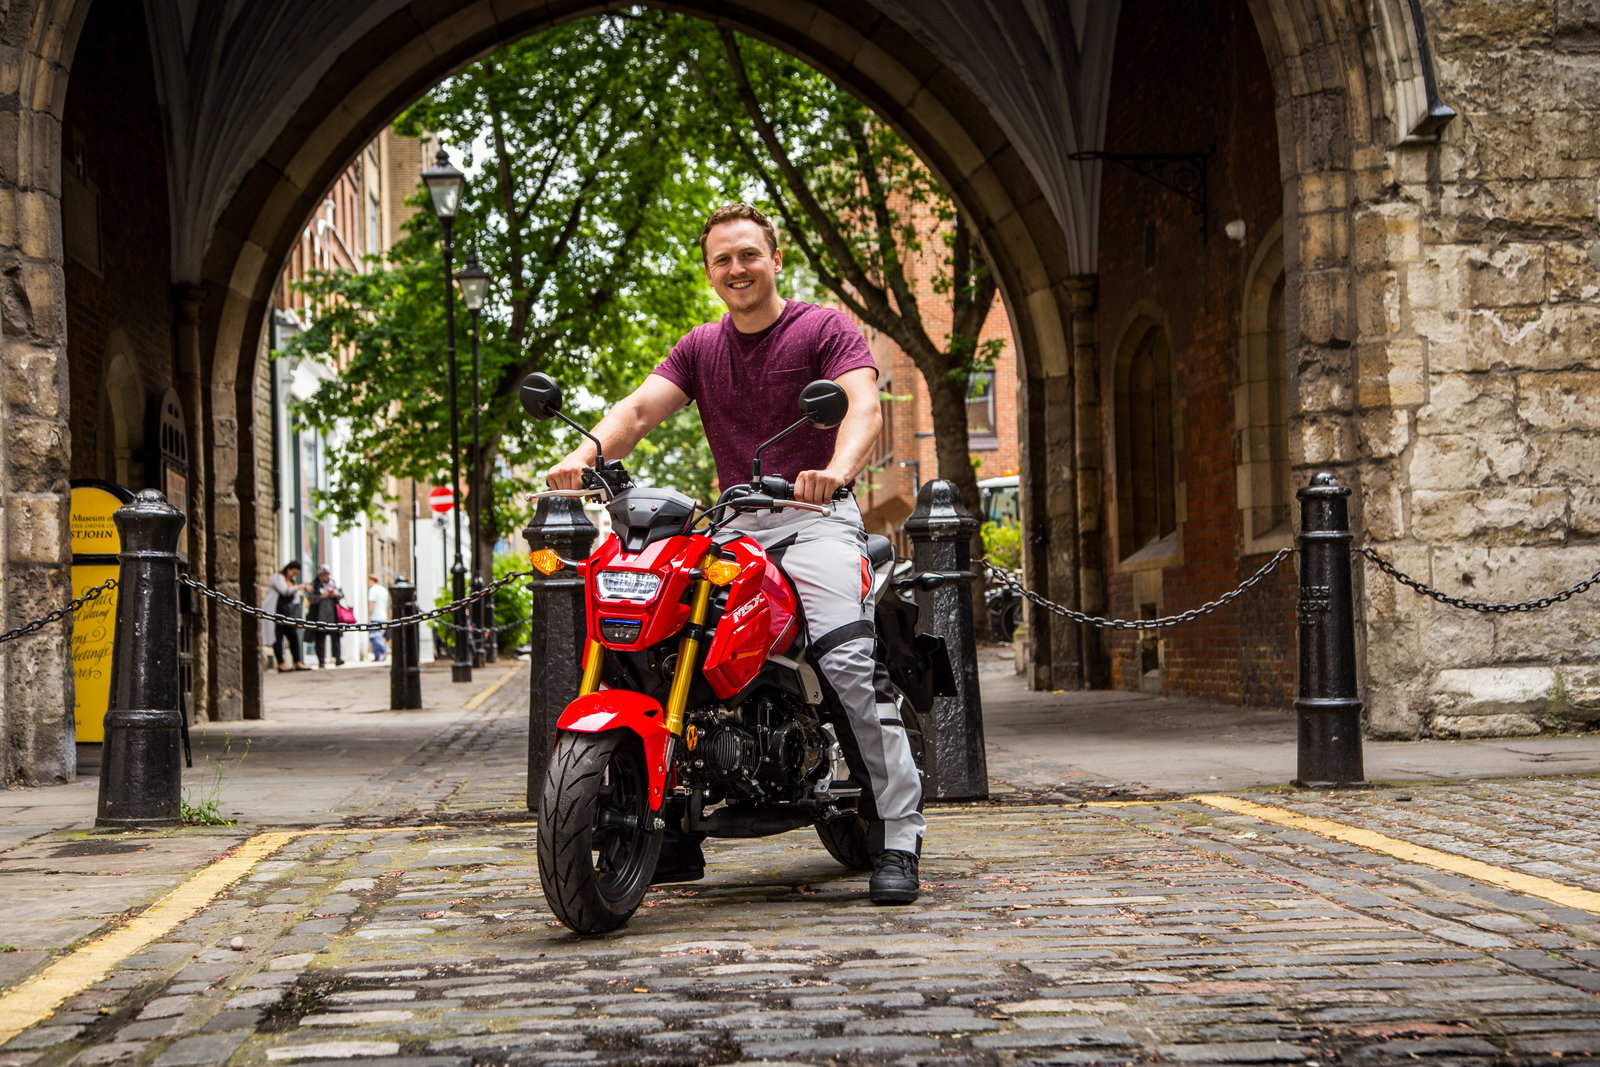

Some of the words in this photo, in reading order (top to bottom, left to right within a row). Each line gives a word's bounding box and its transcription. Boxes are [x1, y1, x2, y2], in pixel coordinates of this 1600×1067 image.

[72, 513, 106, 522] Museum
[82, 530, 114, 541] JOHN
[733, 592, 766, 624] MSX
